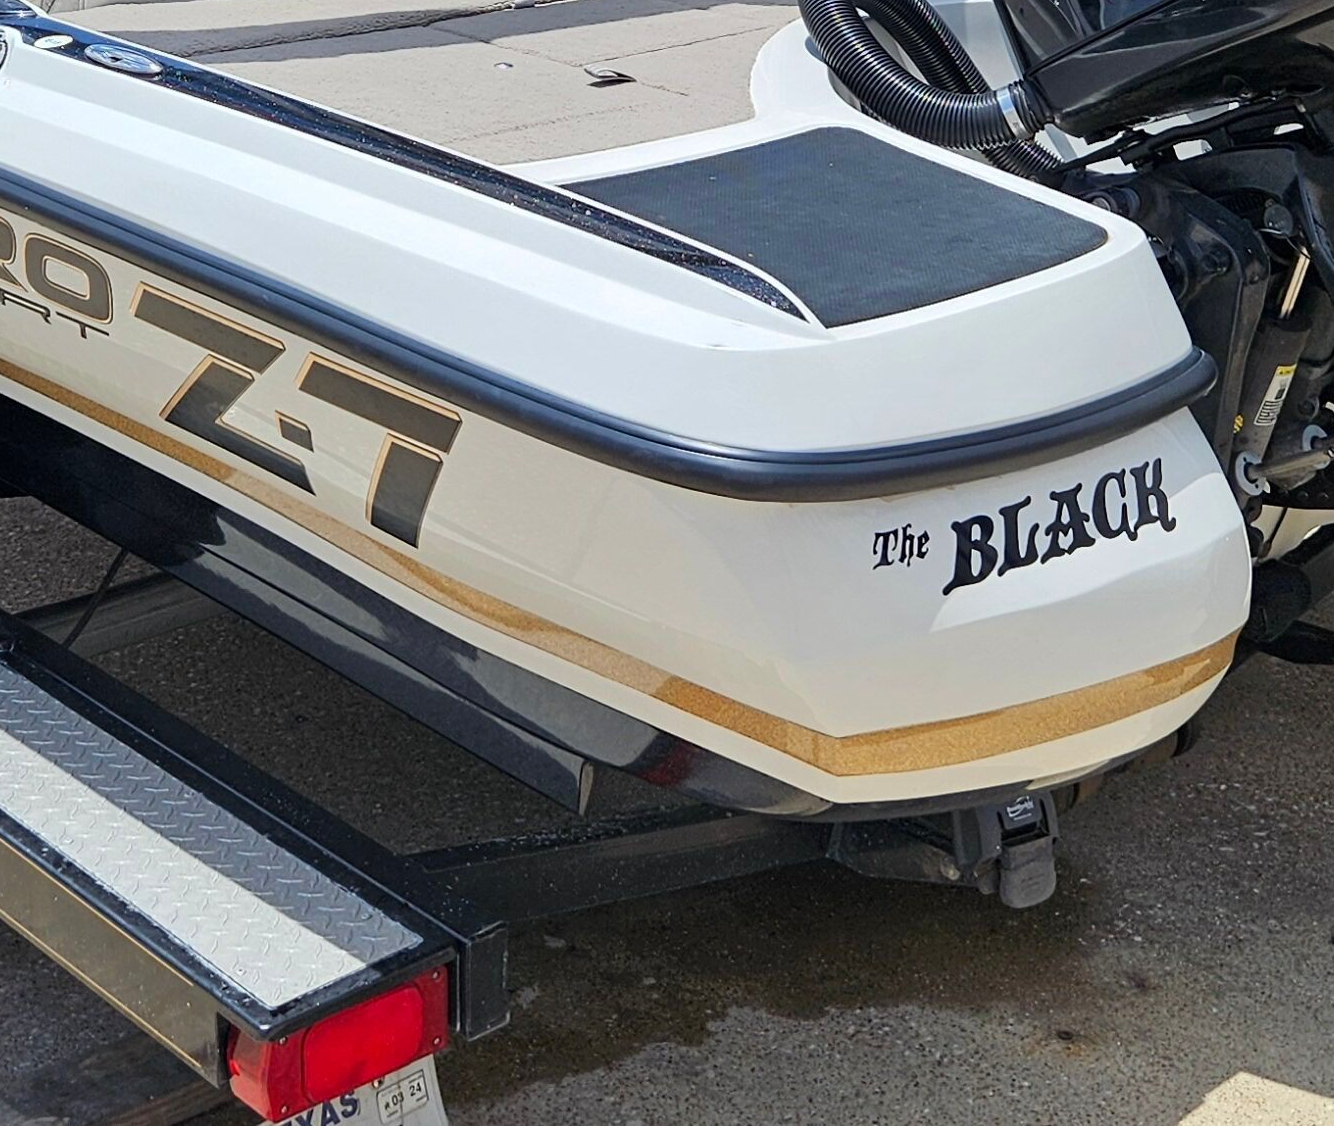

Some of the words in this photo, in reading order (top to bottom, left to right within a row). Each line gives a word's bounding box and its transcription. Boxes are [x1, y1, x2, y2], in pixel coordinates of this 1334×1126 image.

[871, 522, 930, 571] The
[941, 457, 1177, 596] BLACK
[278, 1089, 360, 1126] XAS
[409, 1082, 422, 1097] 24
